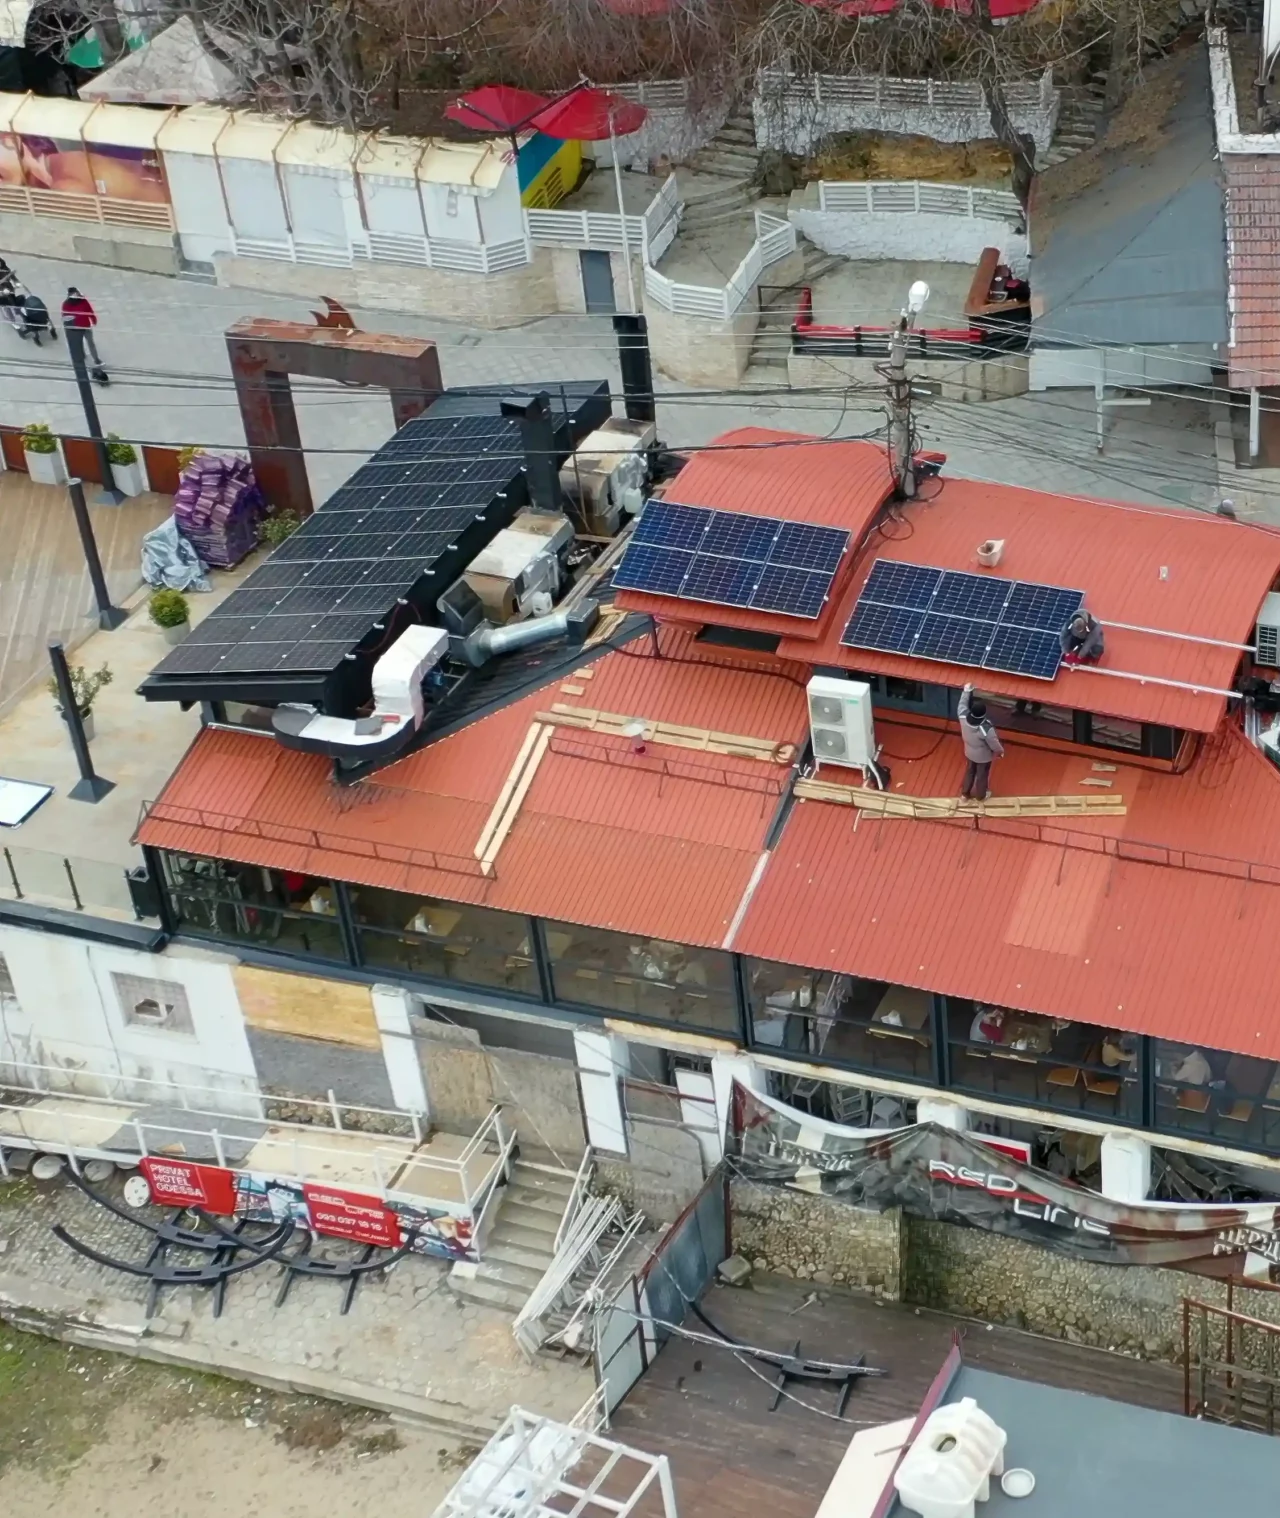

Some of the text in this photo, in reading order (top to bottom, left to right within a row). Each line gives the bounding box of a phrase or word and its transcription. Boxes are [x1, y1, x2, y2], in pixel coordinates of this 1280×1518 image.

[150, 1164, 190, 1178] PRIVAT
[929, 1159, 1018, 1192] RED
[153, 1173, 191, 1186] HOTEL
[156, 1182, 204, 1197] ODESSA
